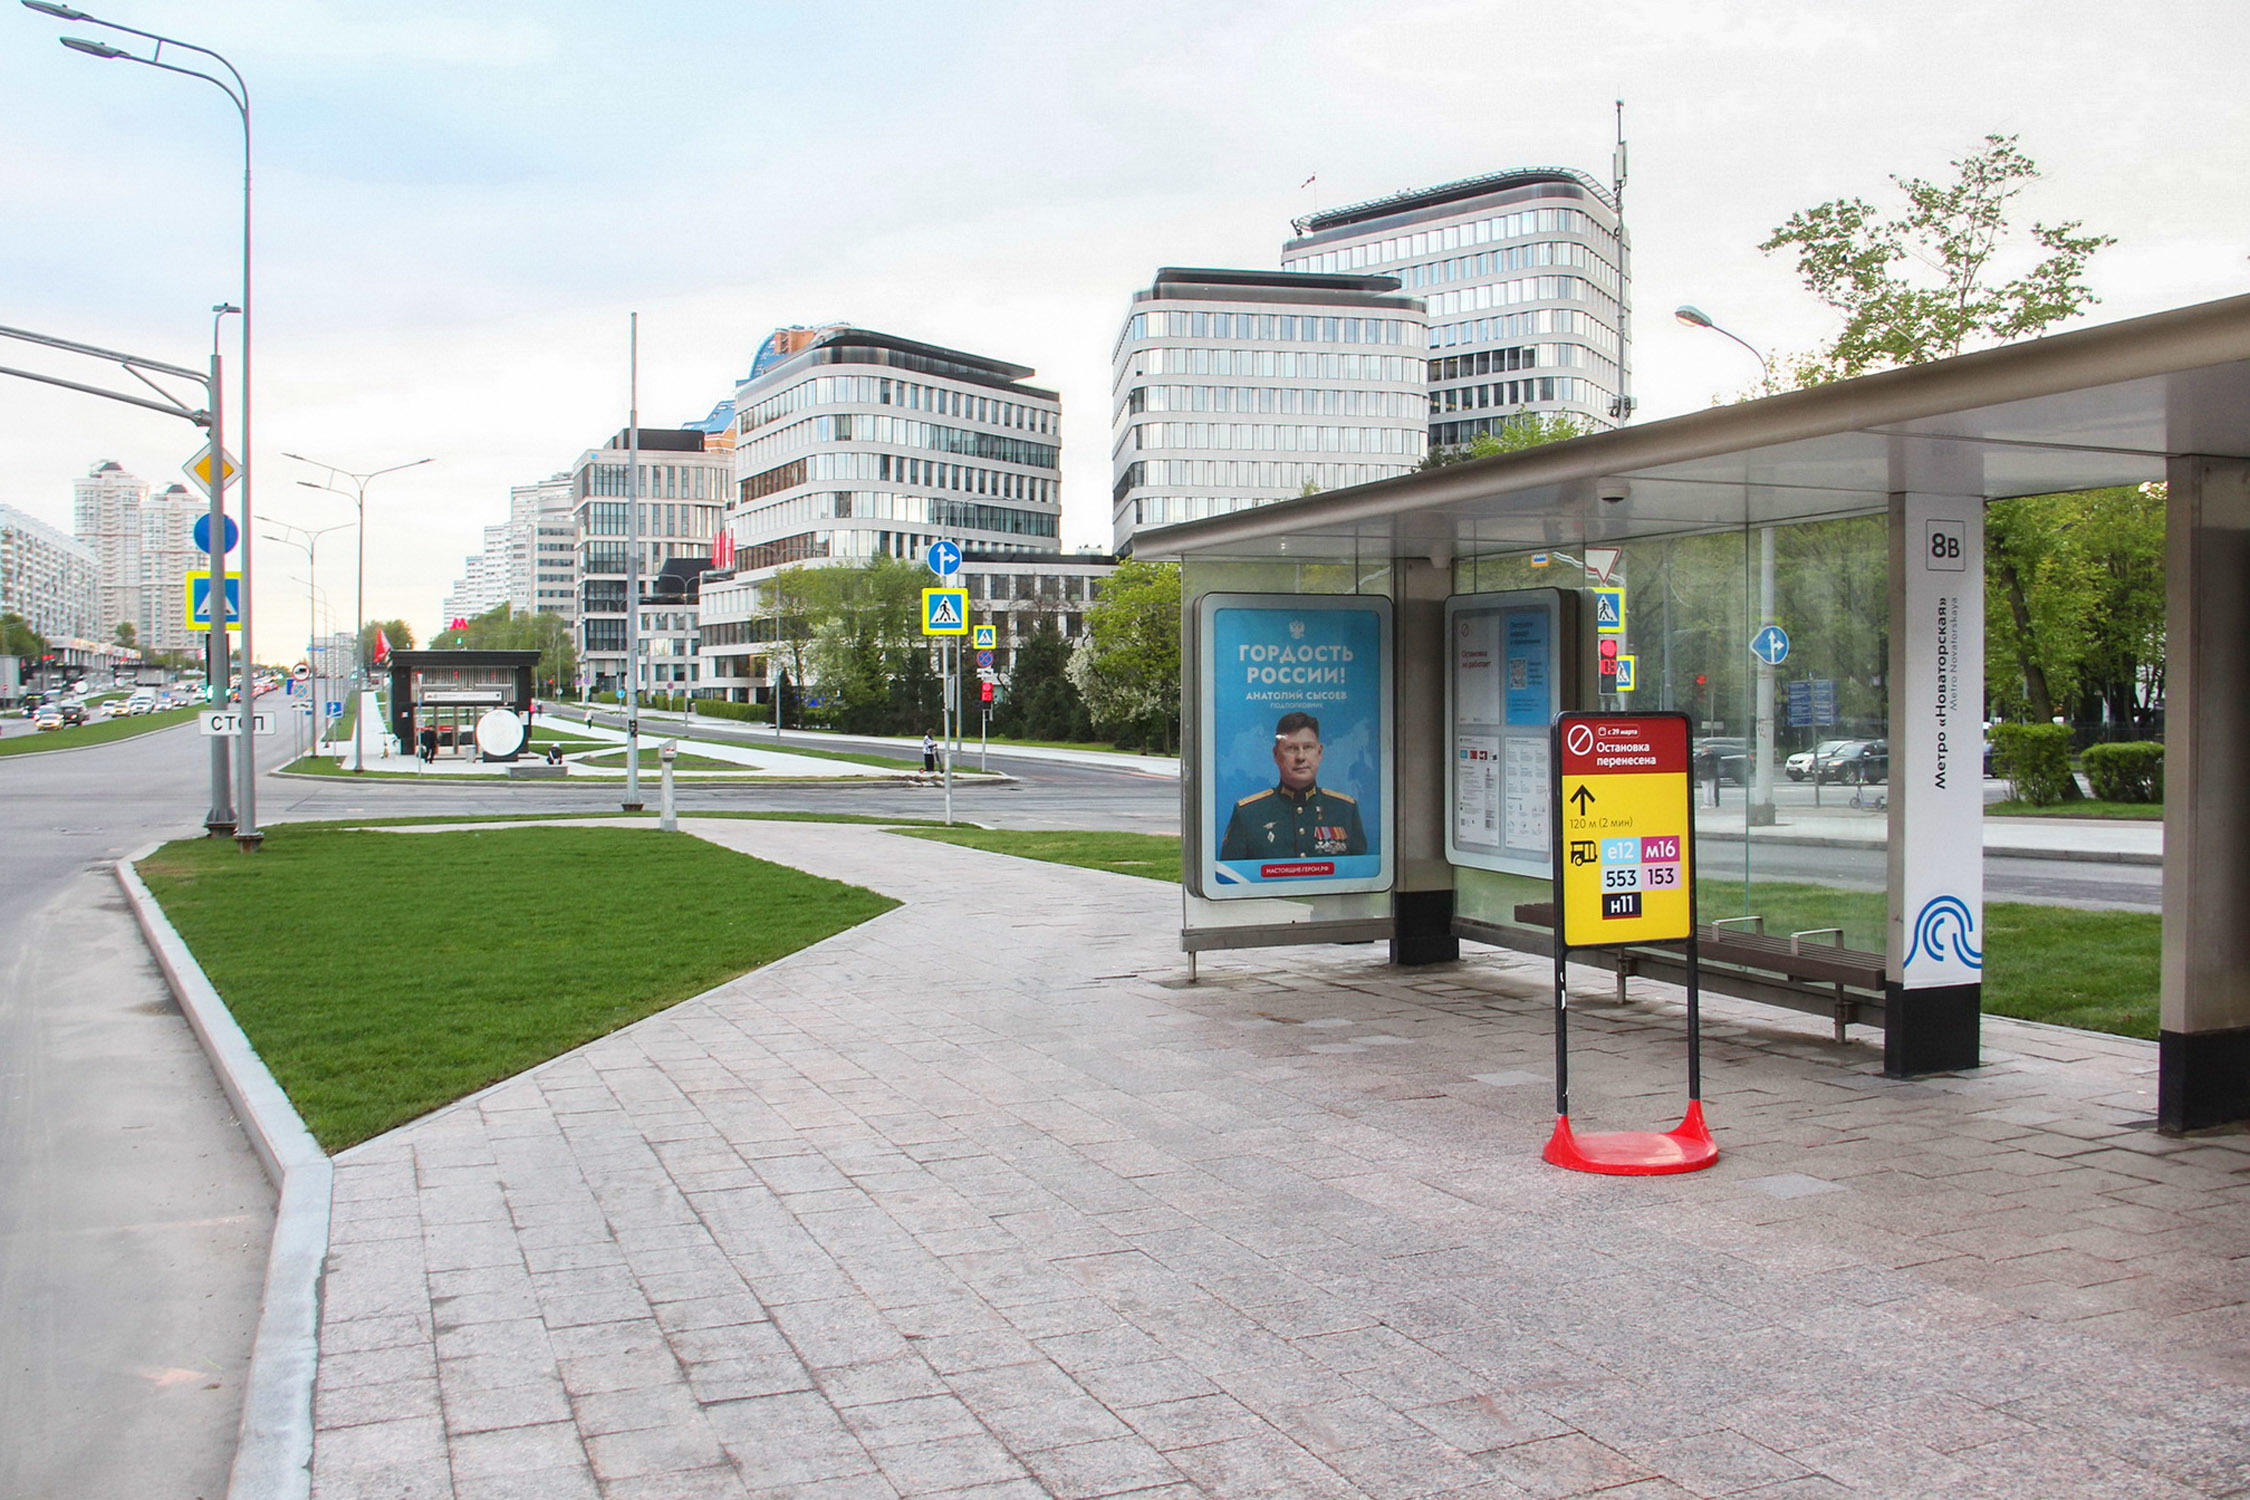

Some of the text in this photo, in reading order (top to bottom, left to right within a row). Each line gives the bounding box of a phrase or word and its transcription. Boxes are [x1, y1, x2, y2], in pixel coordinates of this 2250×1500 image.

[1239, 645, 1354, 663] ГОРДОСТЬ
[1949, 597, 1960, 711] Metro Novatorskaya
[1247, 667, 1346, 684] РОССИИ!
[1246, 689, 1348, 700] АНАТОЛИЙ СЫСОЕВ
[1935, 596, 1949, 790] Метро «Новаторская»
[211, 716, 264, 731] СТП
[1620, 729, 1638, 737] марта
[1596, 742, 1650, 753] Остановка
[1596, 756, 1656, 767] перенесена
[1569, 817, 1633, 829] 120 м (2 мин)
[1607, 840, 1676, 859] е12 м16
[1606, 868, 1674, 887] 553 153
[1610, 895, 1633, 914] н11
